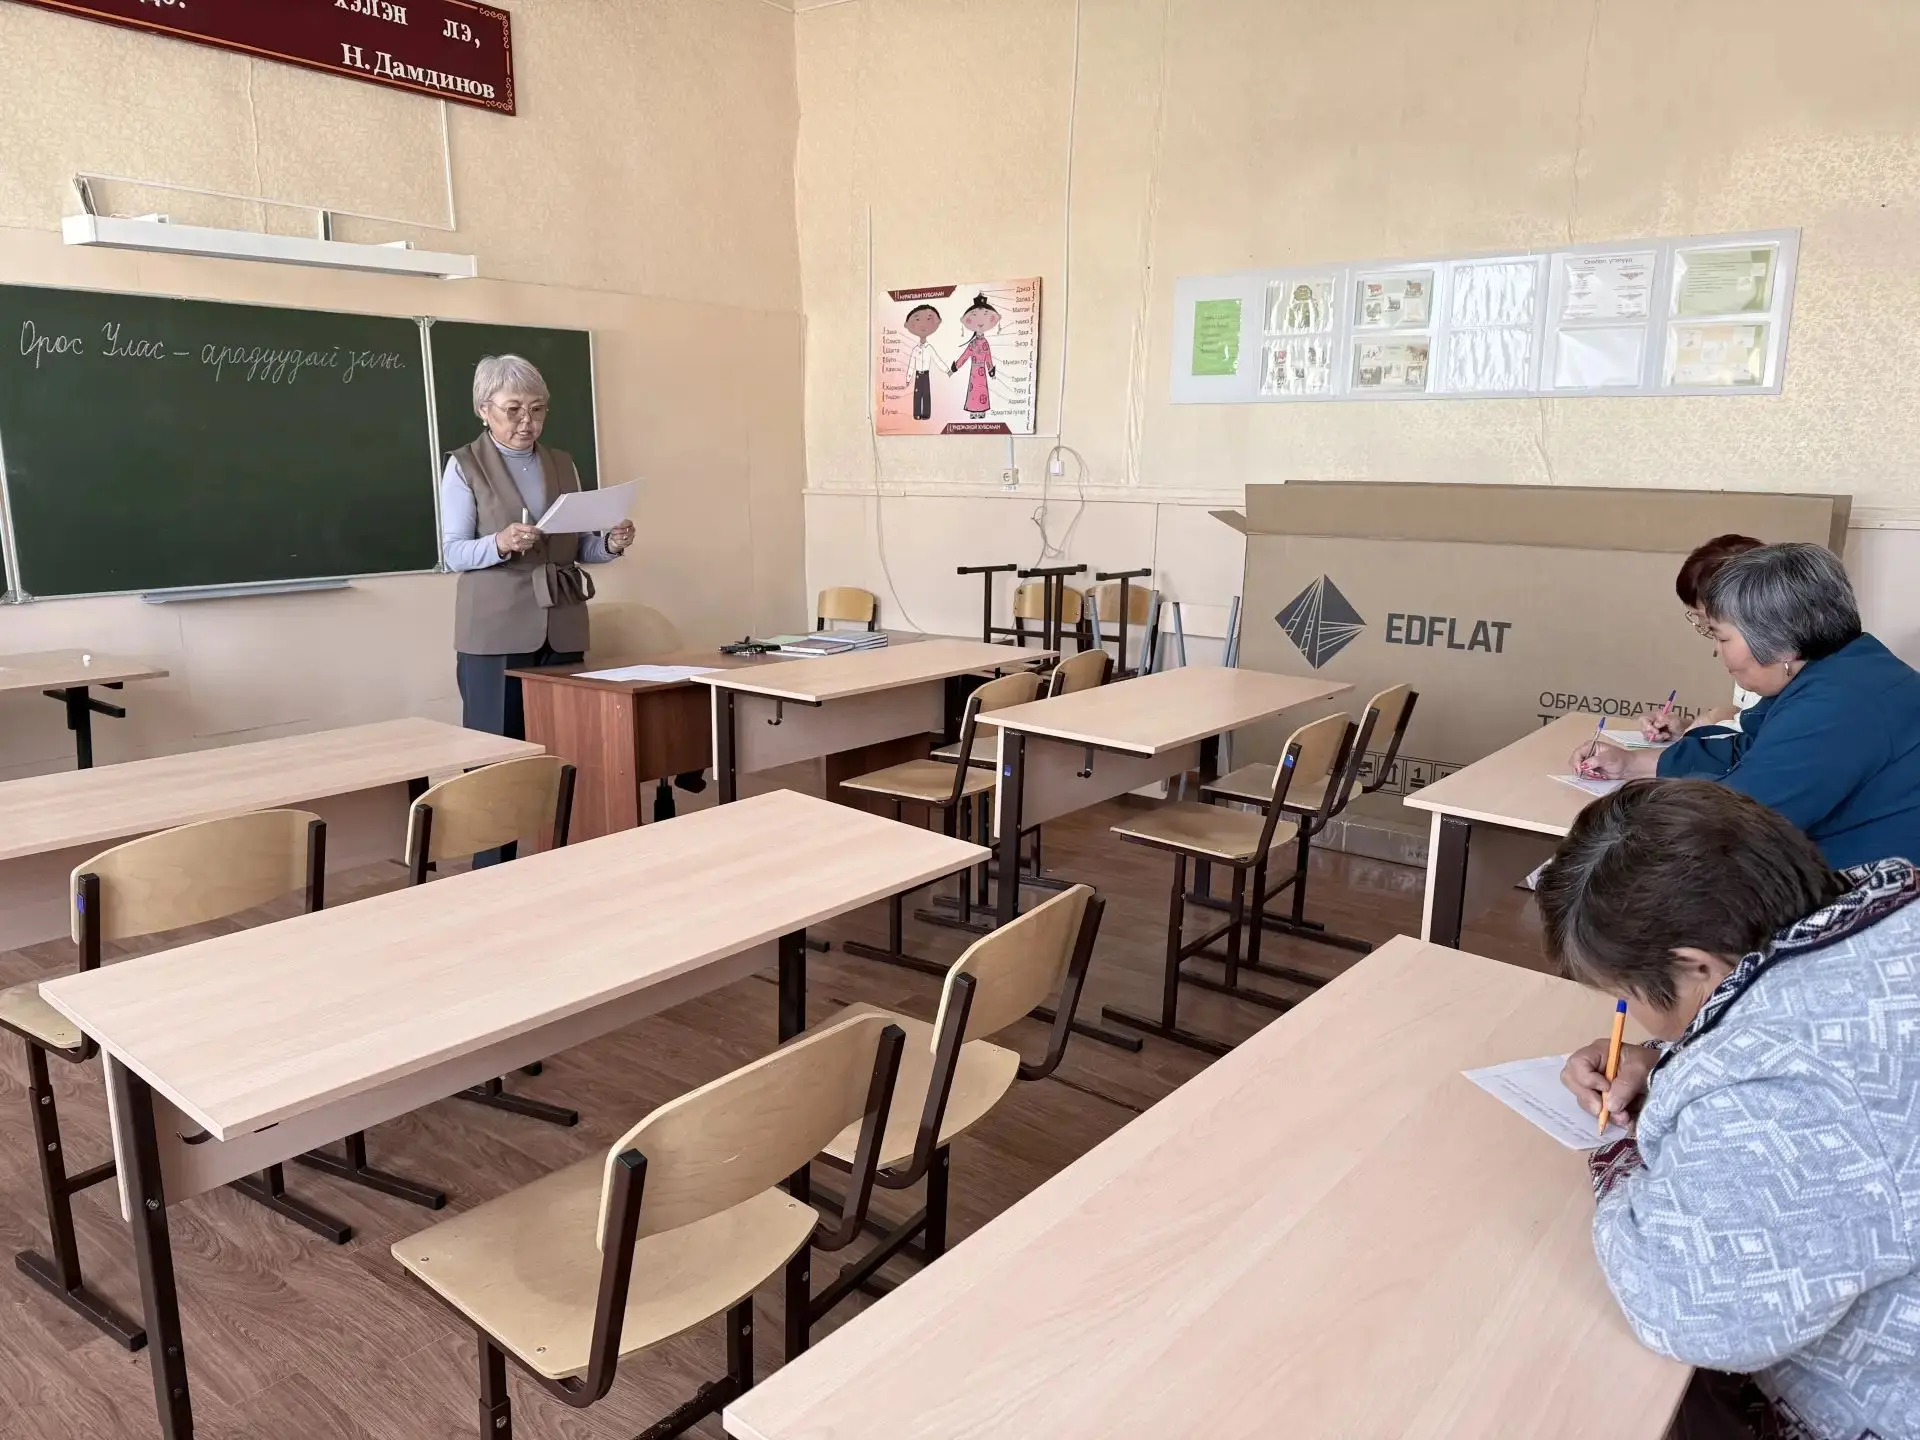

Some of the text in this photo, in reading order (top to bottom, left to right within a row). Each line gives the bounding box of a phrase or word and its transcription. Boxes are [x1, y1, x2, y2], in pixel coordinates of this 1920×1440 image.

[21, 320, 83, 369] Орос
[101, 321, 166, 360] Улас
[1385, 612, 1512, 654] EDFLAT
